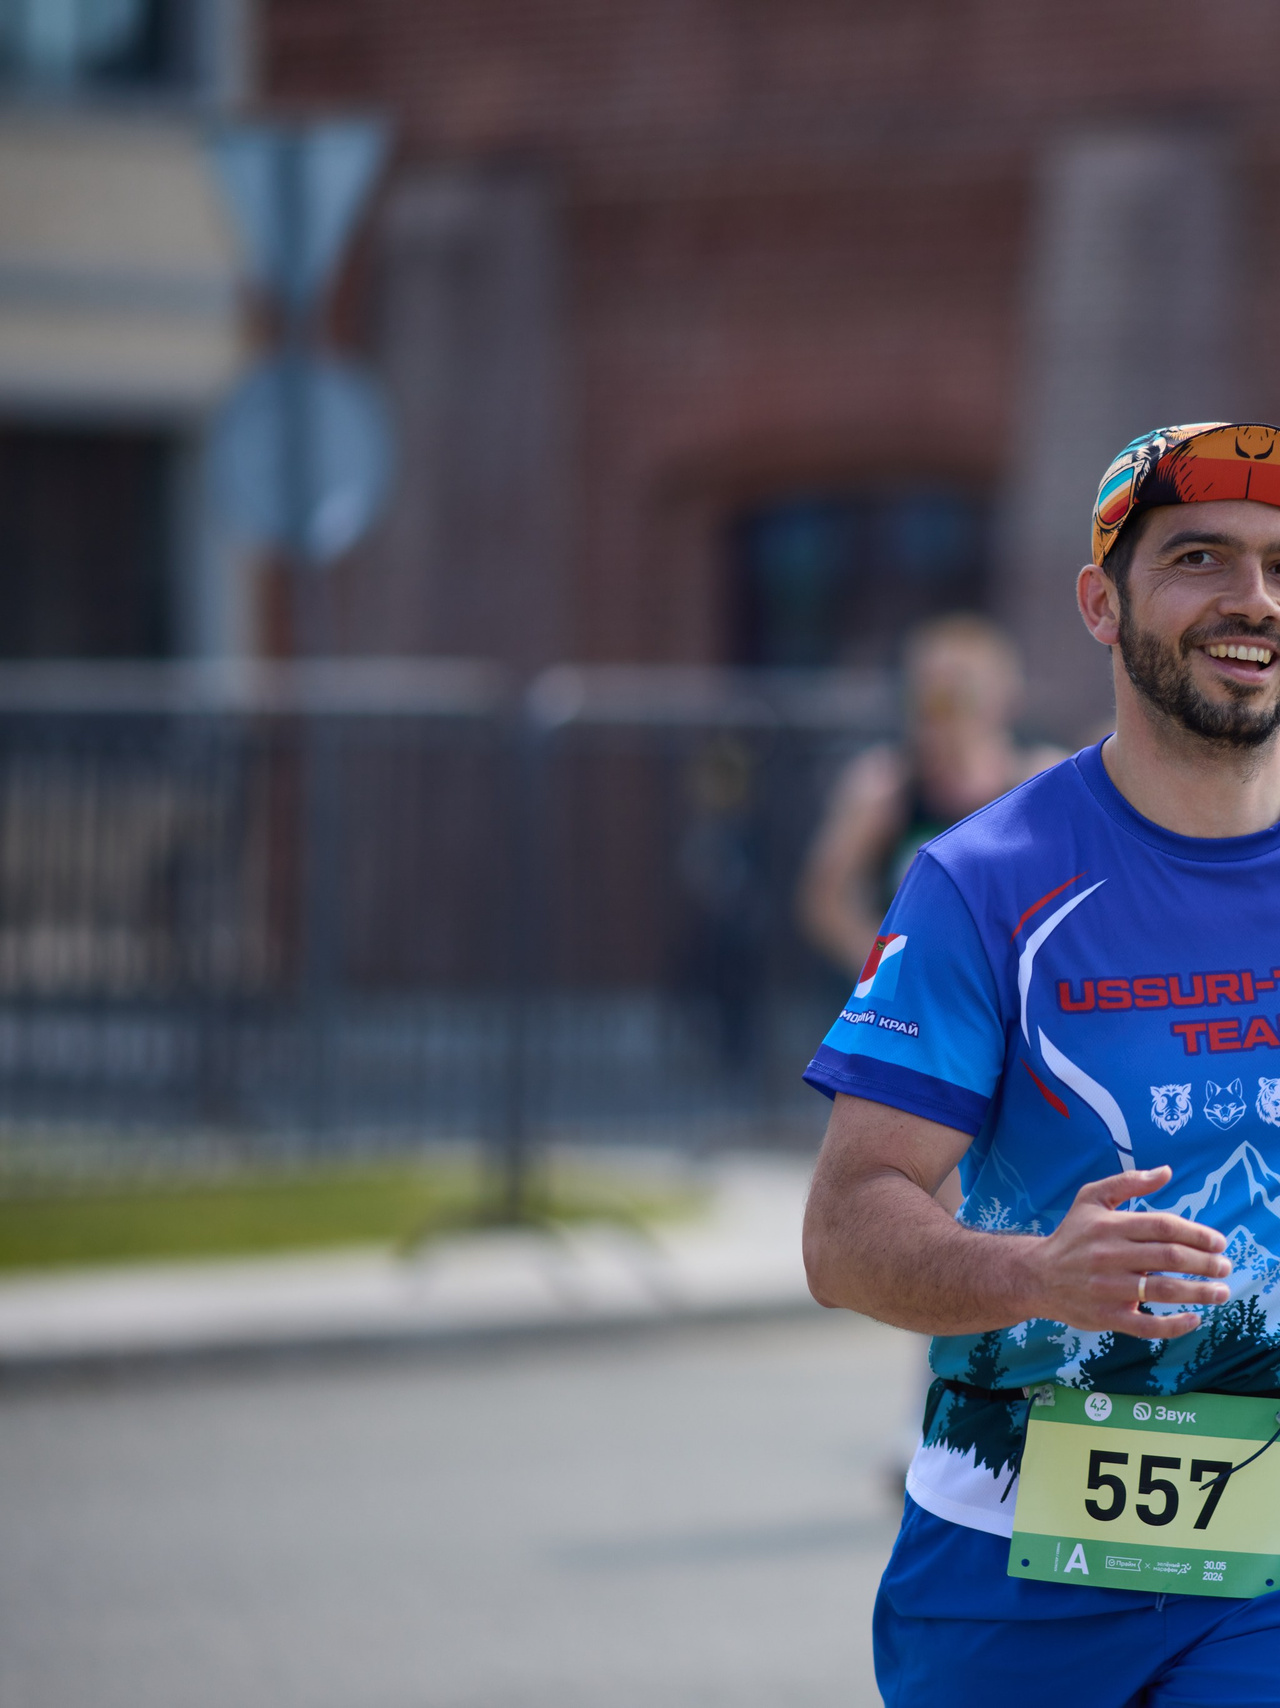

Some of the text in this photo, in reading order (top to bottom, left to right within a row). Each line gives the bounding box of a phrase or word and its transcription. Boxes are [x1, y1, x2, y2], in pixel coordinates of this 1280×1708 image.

[878, 1017, 919, 1037] КРАЙ
[1089, 1397, 1108, 1412] 4,2
[1154, 1405, 1197, 1425] Звук
[1084, 1449, 1233, 1530] 557
[1203, 1560, 1227, 1571] 30.05
[1202, 1571, 1224, 1582] 2026
